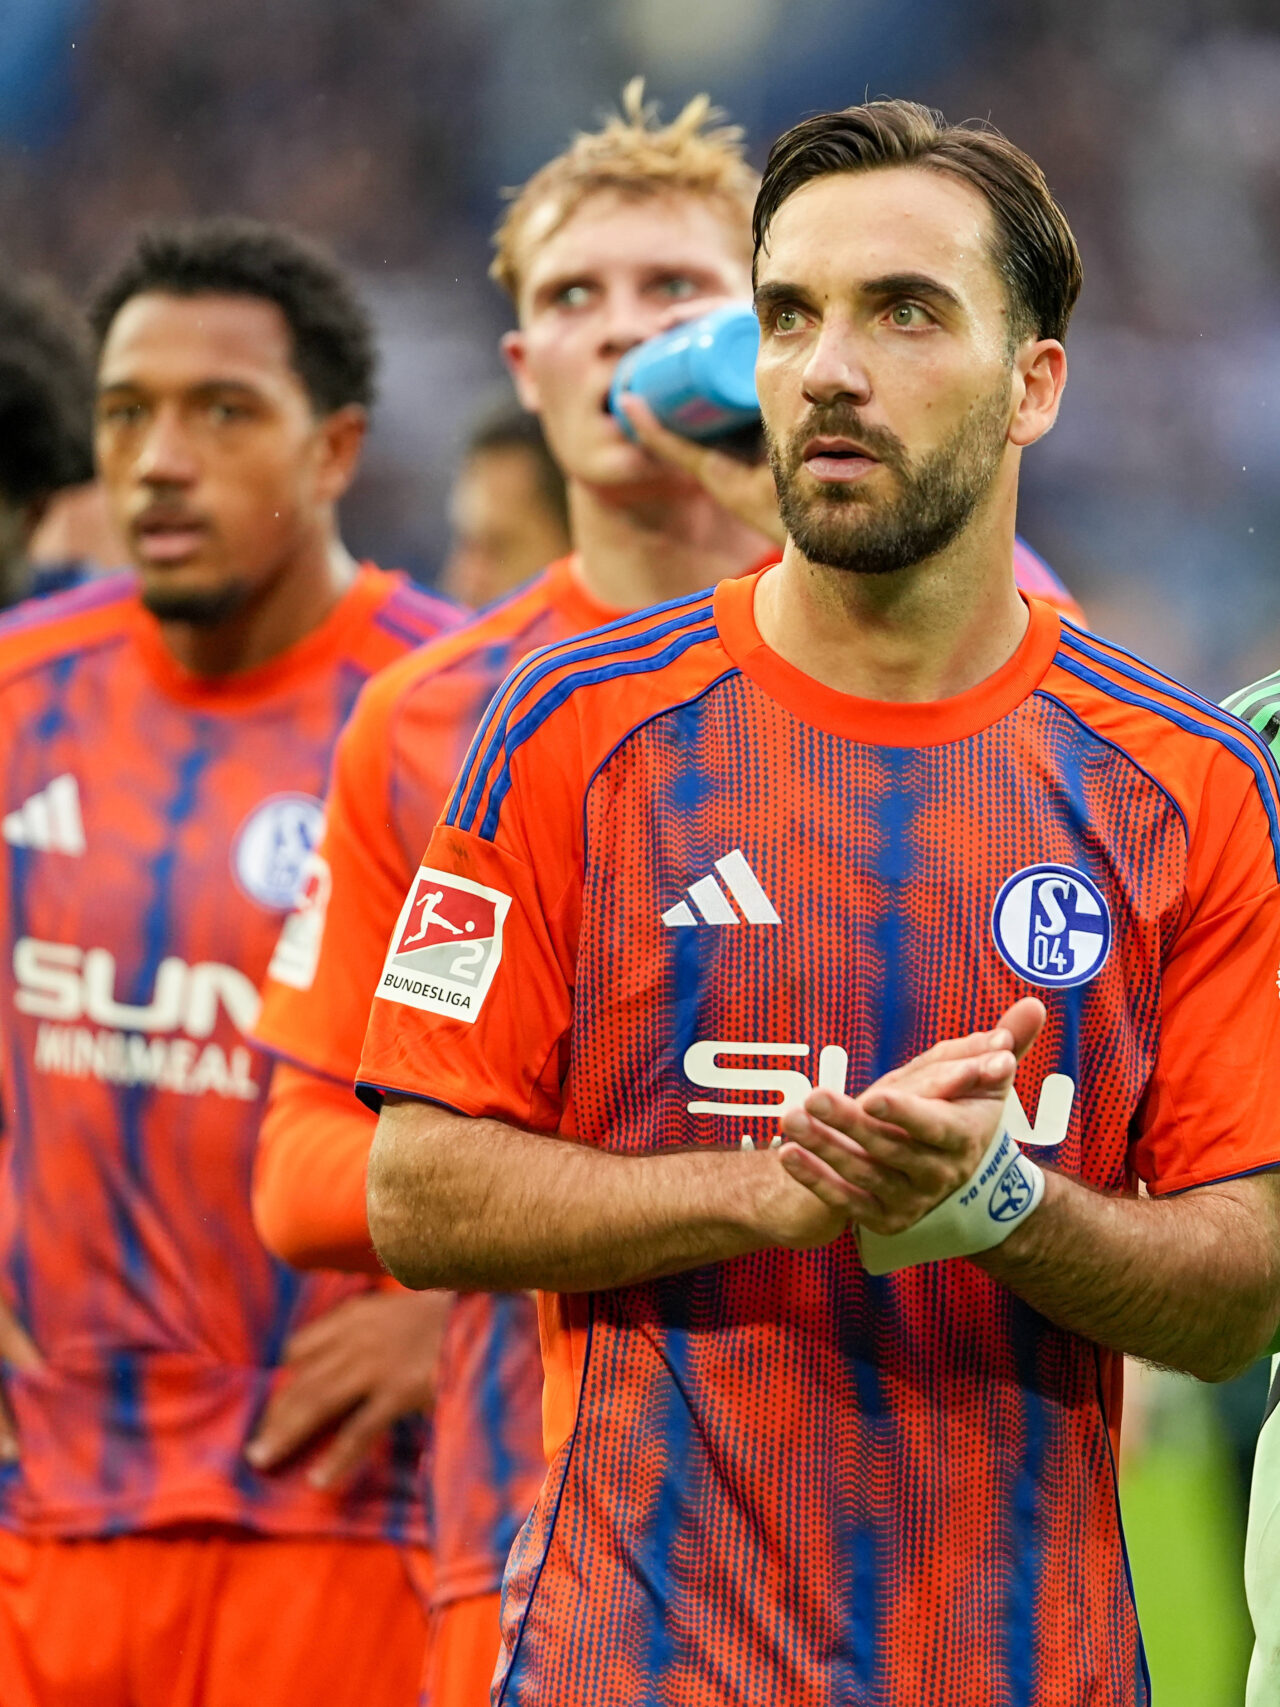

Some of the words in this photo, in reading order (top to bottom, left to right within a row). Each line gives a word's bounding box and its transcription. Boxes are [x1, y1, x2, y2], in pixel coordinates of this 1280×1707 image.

[449, 941, 485, 981] 2
[1033, 935, 1067, 973] 04
[383, 973, 471, 1009] BUNDESLIGA
[980, 1129, 1010, 1186] chalke
